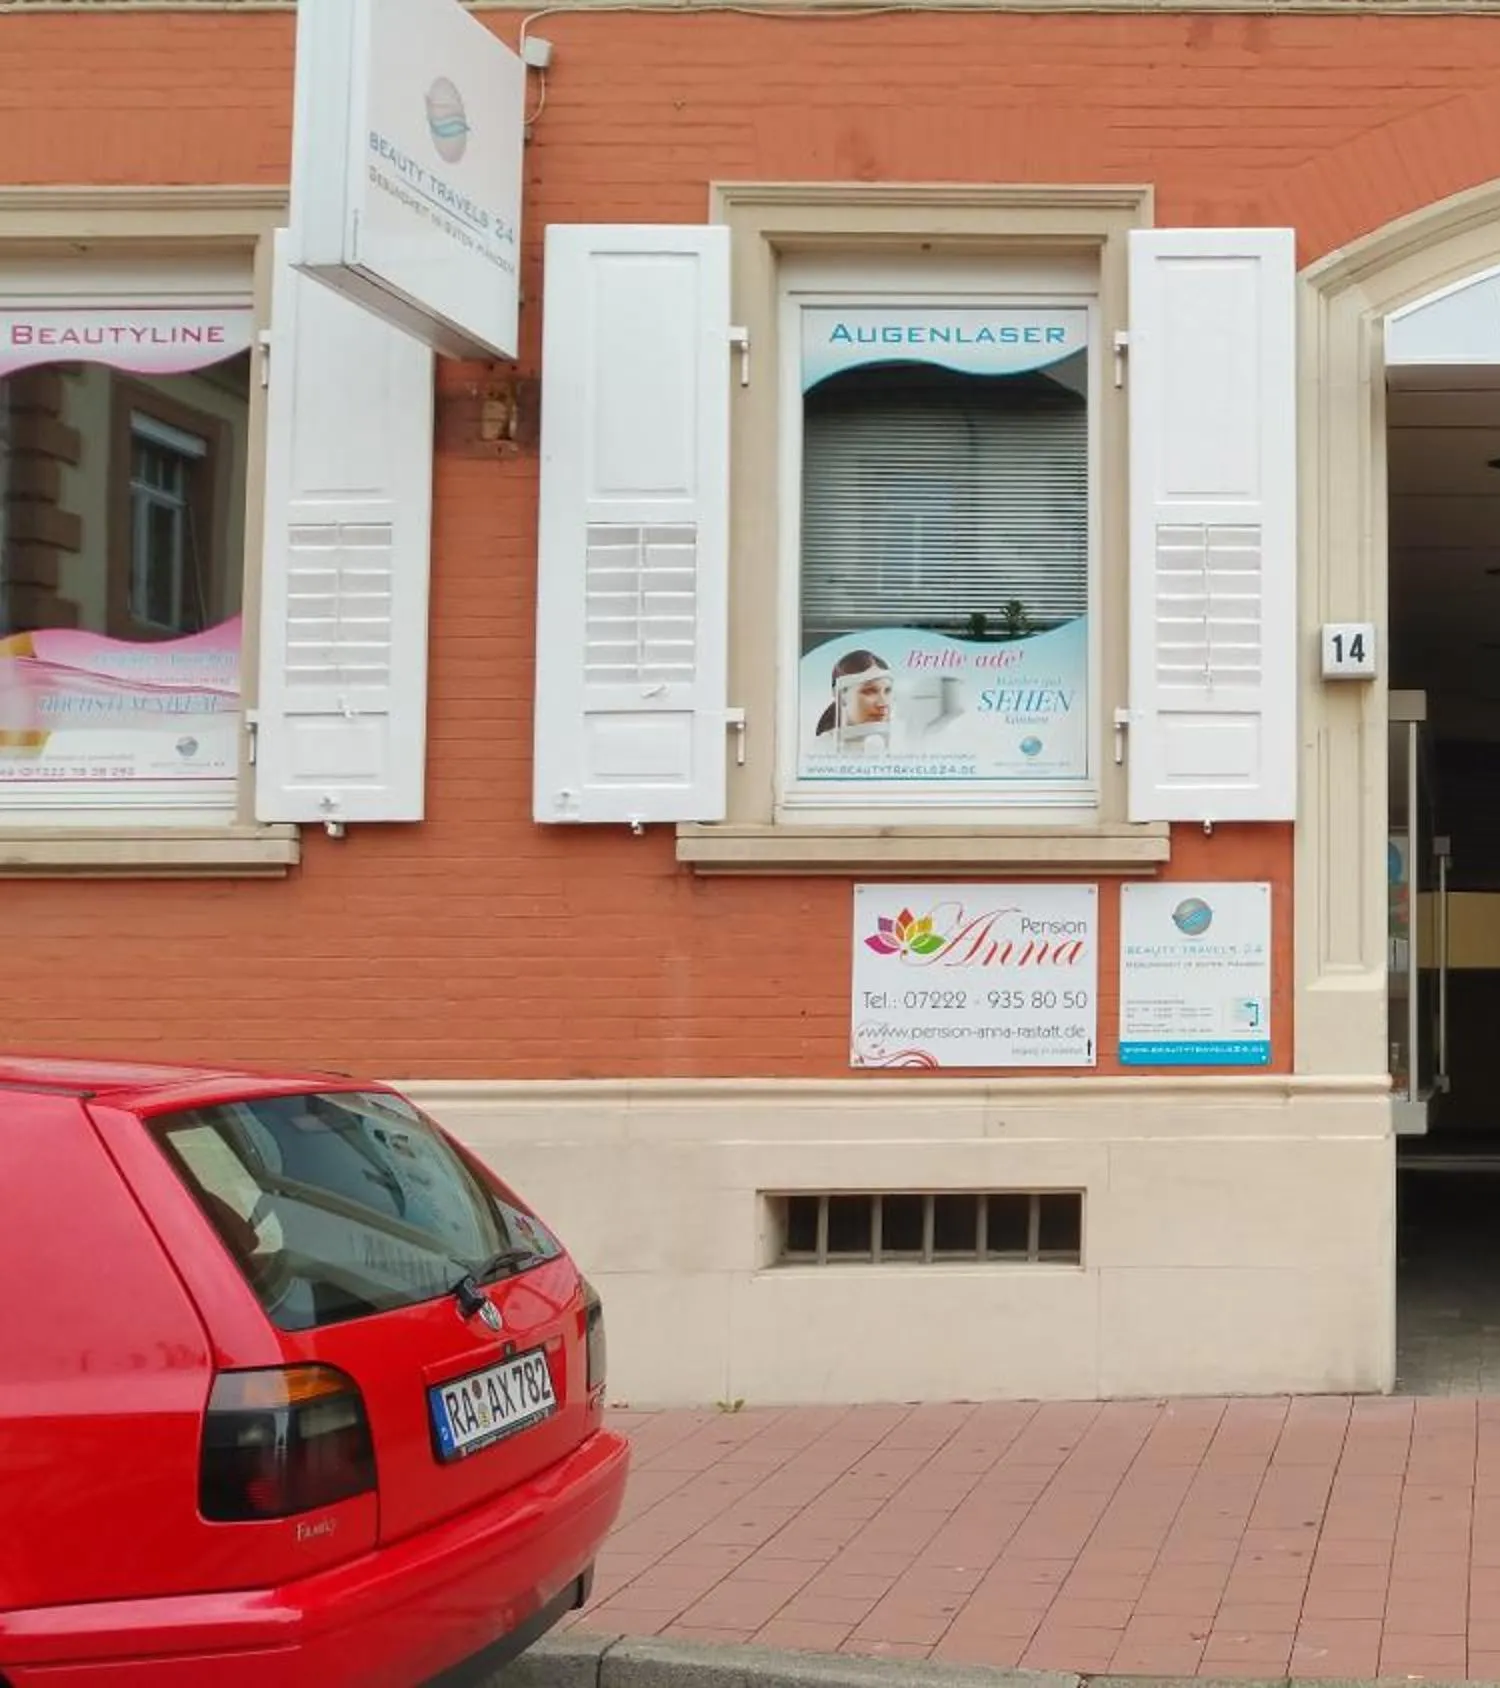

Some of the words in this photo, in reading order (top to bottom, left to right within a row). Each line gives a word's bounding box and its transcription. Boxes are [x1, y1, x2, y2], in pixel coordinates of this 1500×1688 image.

[369, 130, 424, 183] BEAUTY
[430, 174, 490, 229] TRAVELS
[495, 217, 514, 246] 24
[11, 324, 226, 345] BEAUTYLINE
[829, 323, 1067, 343] AUGENLASER
[1332, 633, 1366, 663] 14
[905, 649, 967, 669] Brille
[975, 649, 1025, 669] ade!
[977, 689, 1076, 712] SEHEN
[902, 901, 1087, 967] Anna
[1021, 917, 1087, 935] Pension
[863, 991, 897, 1009] Tel.:
[903, 991, 967, 1009] 07222
[986, 990, 1025, 1009] 935
[1031, 991, 1057, 1009] 80
[1062, 991, 1087, 1009] 50
[864, 1024, 1086, 1040] www.pension-anna-rastatt.de
[445, 1387, 479, 1439] RA
[487, 1371, 518, 1422] AX
[511, 1357, 552, 1409] 782
